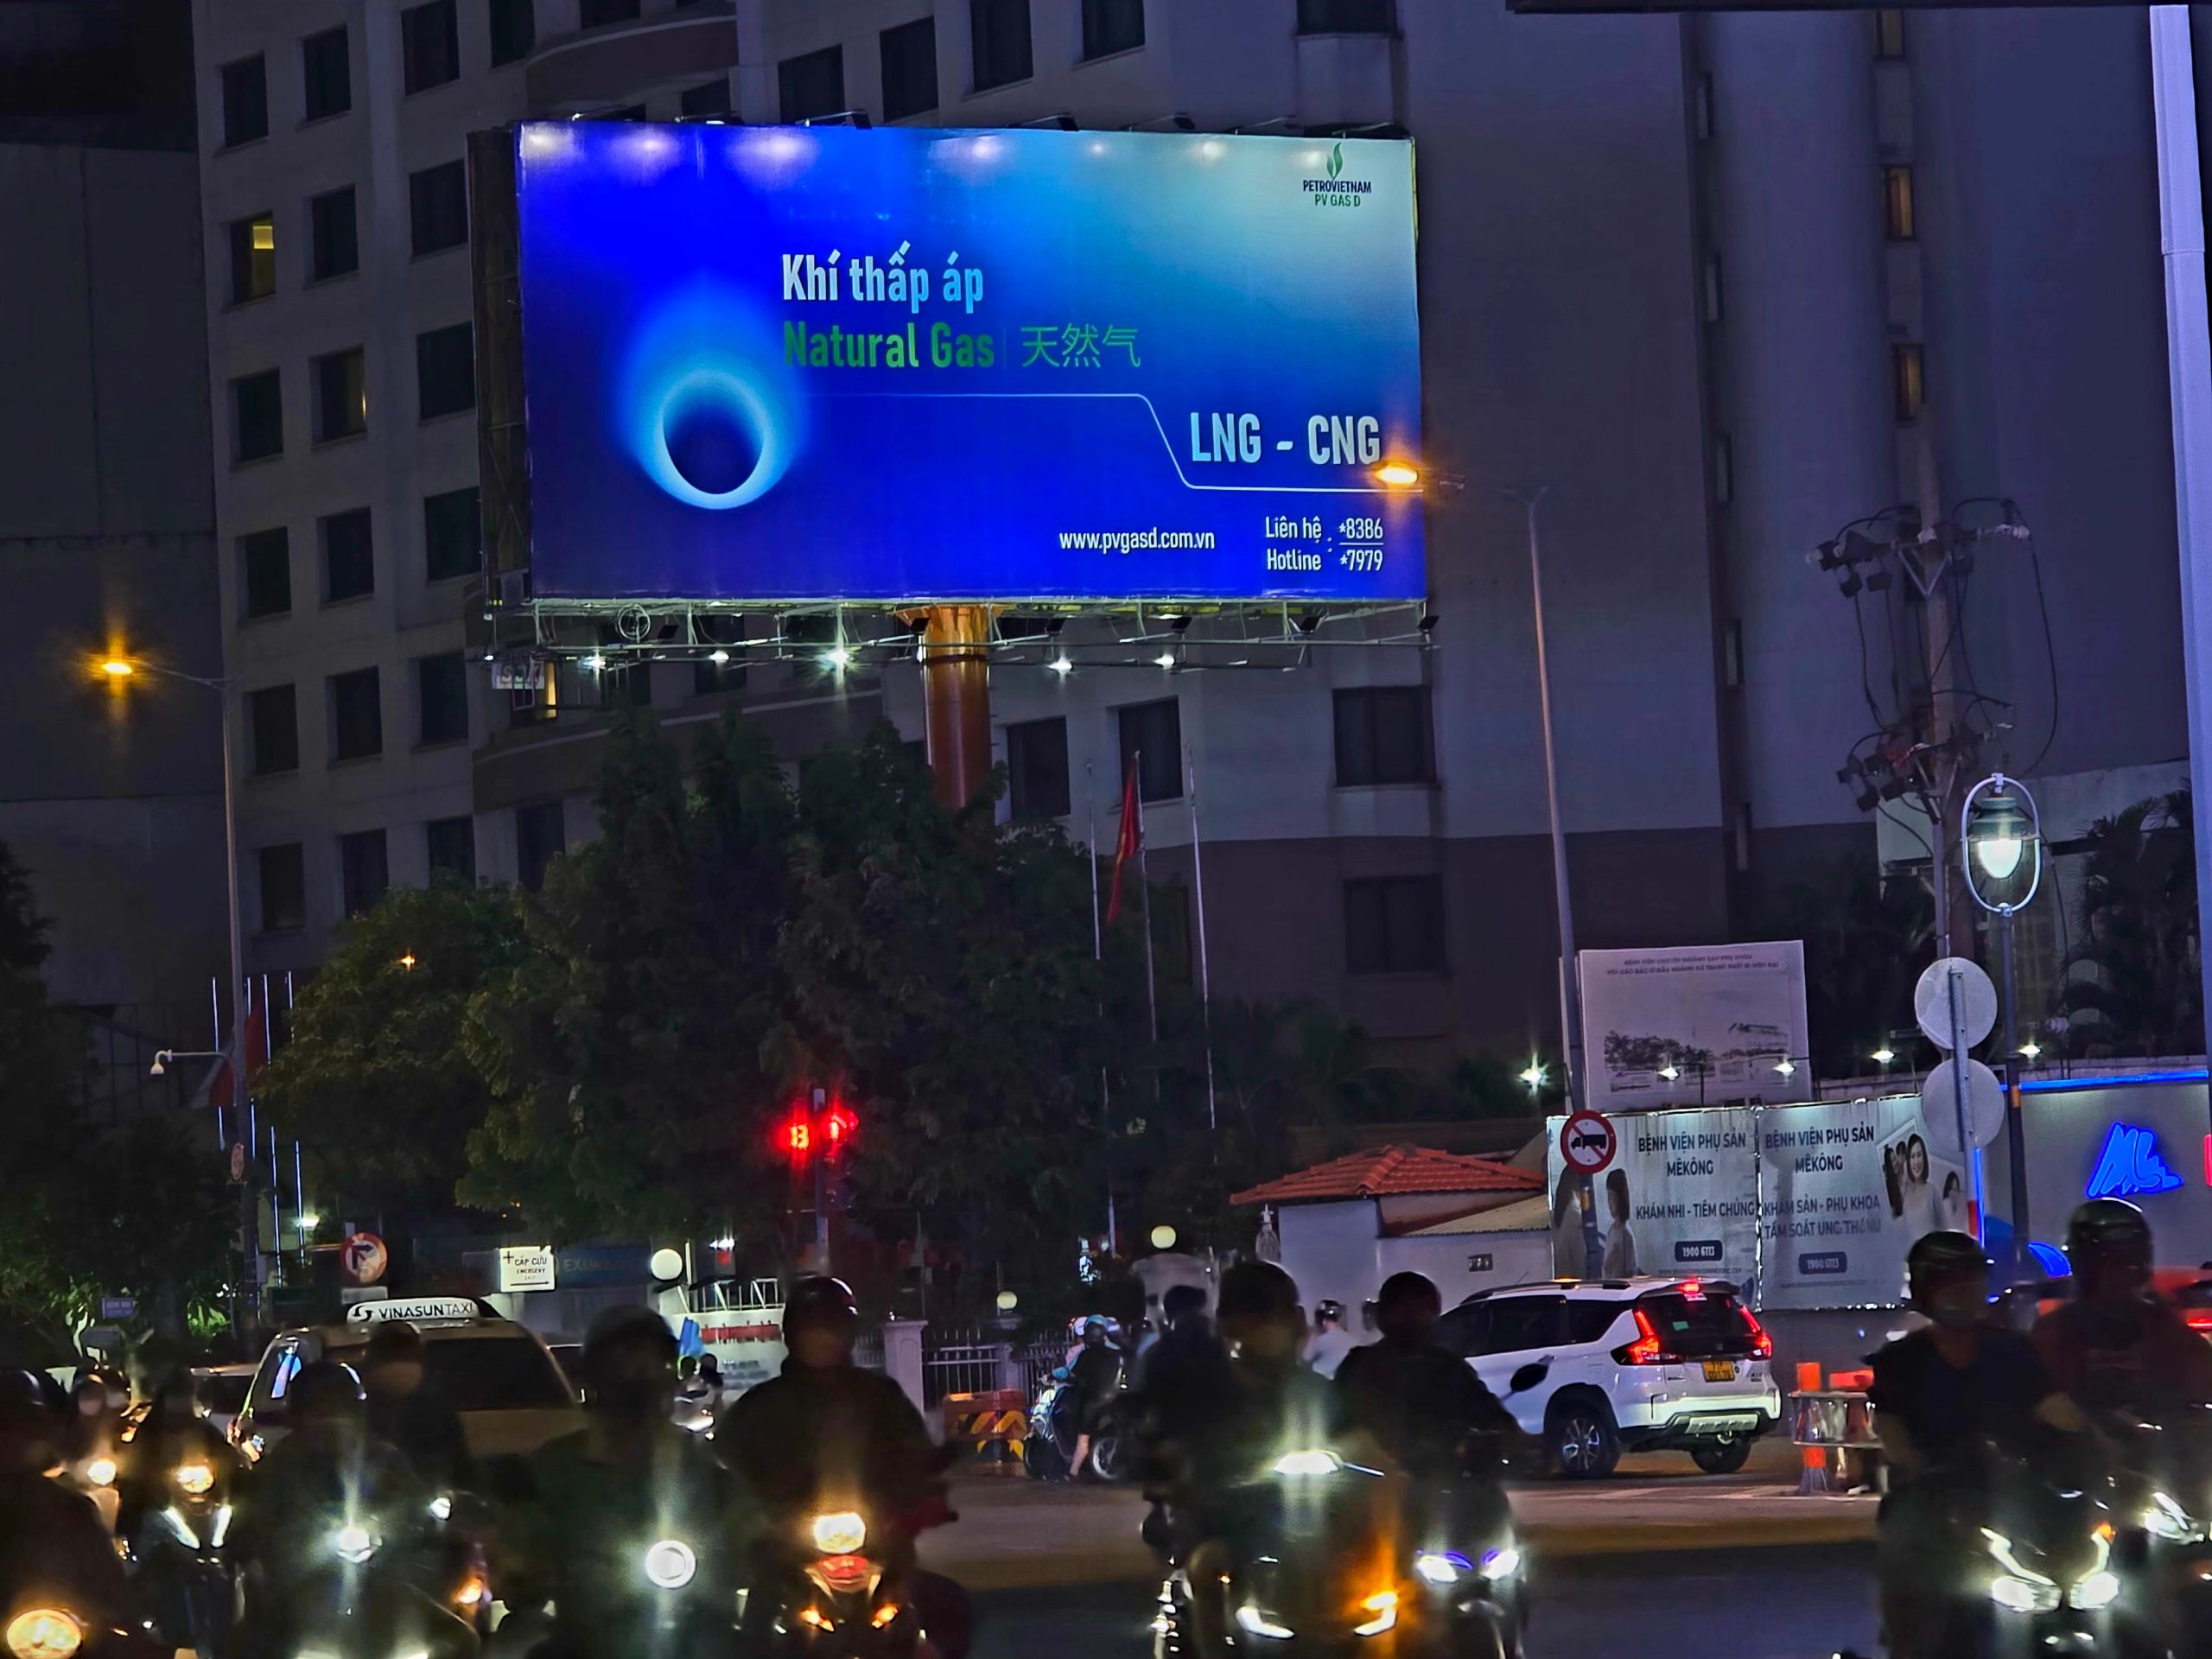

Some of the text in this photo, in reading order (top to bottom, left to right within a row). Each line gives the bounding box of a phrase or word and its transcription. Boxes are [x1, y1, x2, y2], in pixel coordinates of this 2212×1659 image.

[1303, 180, 1372, 194] PETROVIETNAM
[1315, 194, 1361, 207] PV GAS D
[782, 240, 984, 315] Khí thấp áp
[783, 321, 995, 368] Natural Gas
[1020, 322, 1141, 368] 天然气
[1190, 412, 1381, 466] LNG - CNG
[1059, 527, 1216, 555] www.pvgasd.com.vn
[1265, 516, 1298, 539] Liên
[1302, 516, 1323, 543] hệ
[1267, 548, 1323, 571] Hotline
[1638, 1127, 1746, 1155] BỆNH VIỆN PHỤ SẢN
[1765, 1121, 1874, 1152] BỆNH VIỆN PHỤ SẢN
[1667, 1157, 1714, 1177] MÊKÔNG
[1795, 1152, 1844, 1173] MÊKÔNG
[1637, 1202, 1665, 1220] KHÁM
[1668, 1204, 1685, 1218] NHI
[1796, 1193, 1817, 1214] SẢN
[1826, 1197, 1848, 1215] PHỤ
[1851, 1195, 1880, 1211] KHOA
[1789, 1217, 1815, 1238] SOÁT
[1682, 1246, 1700, 1257] 1900
